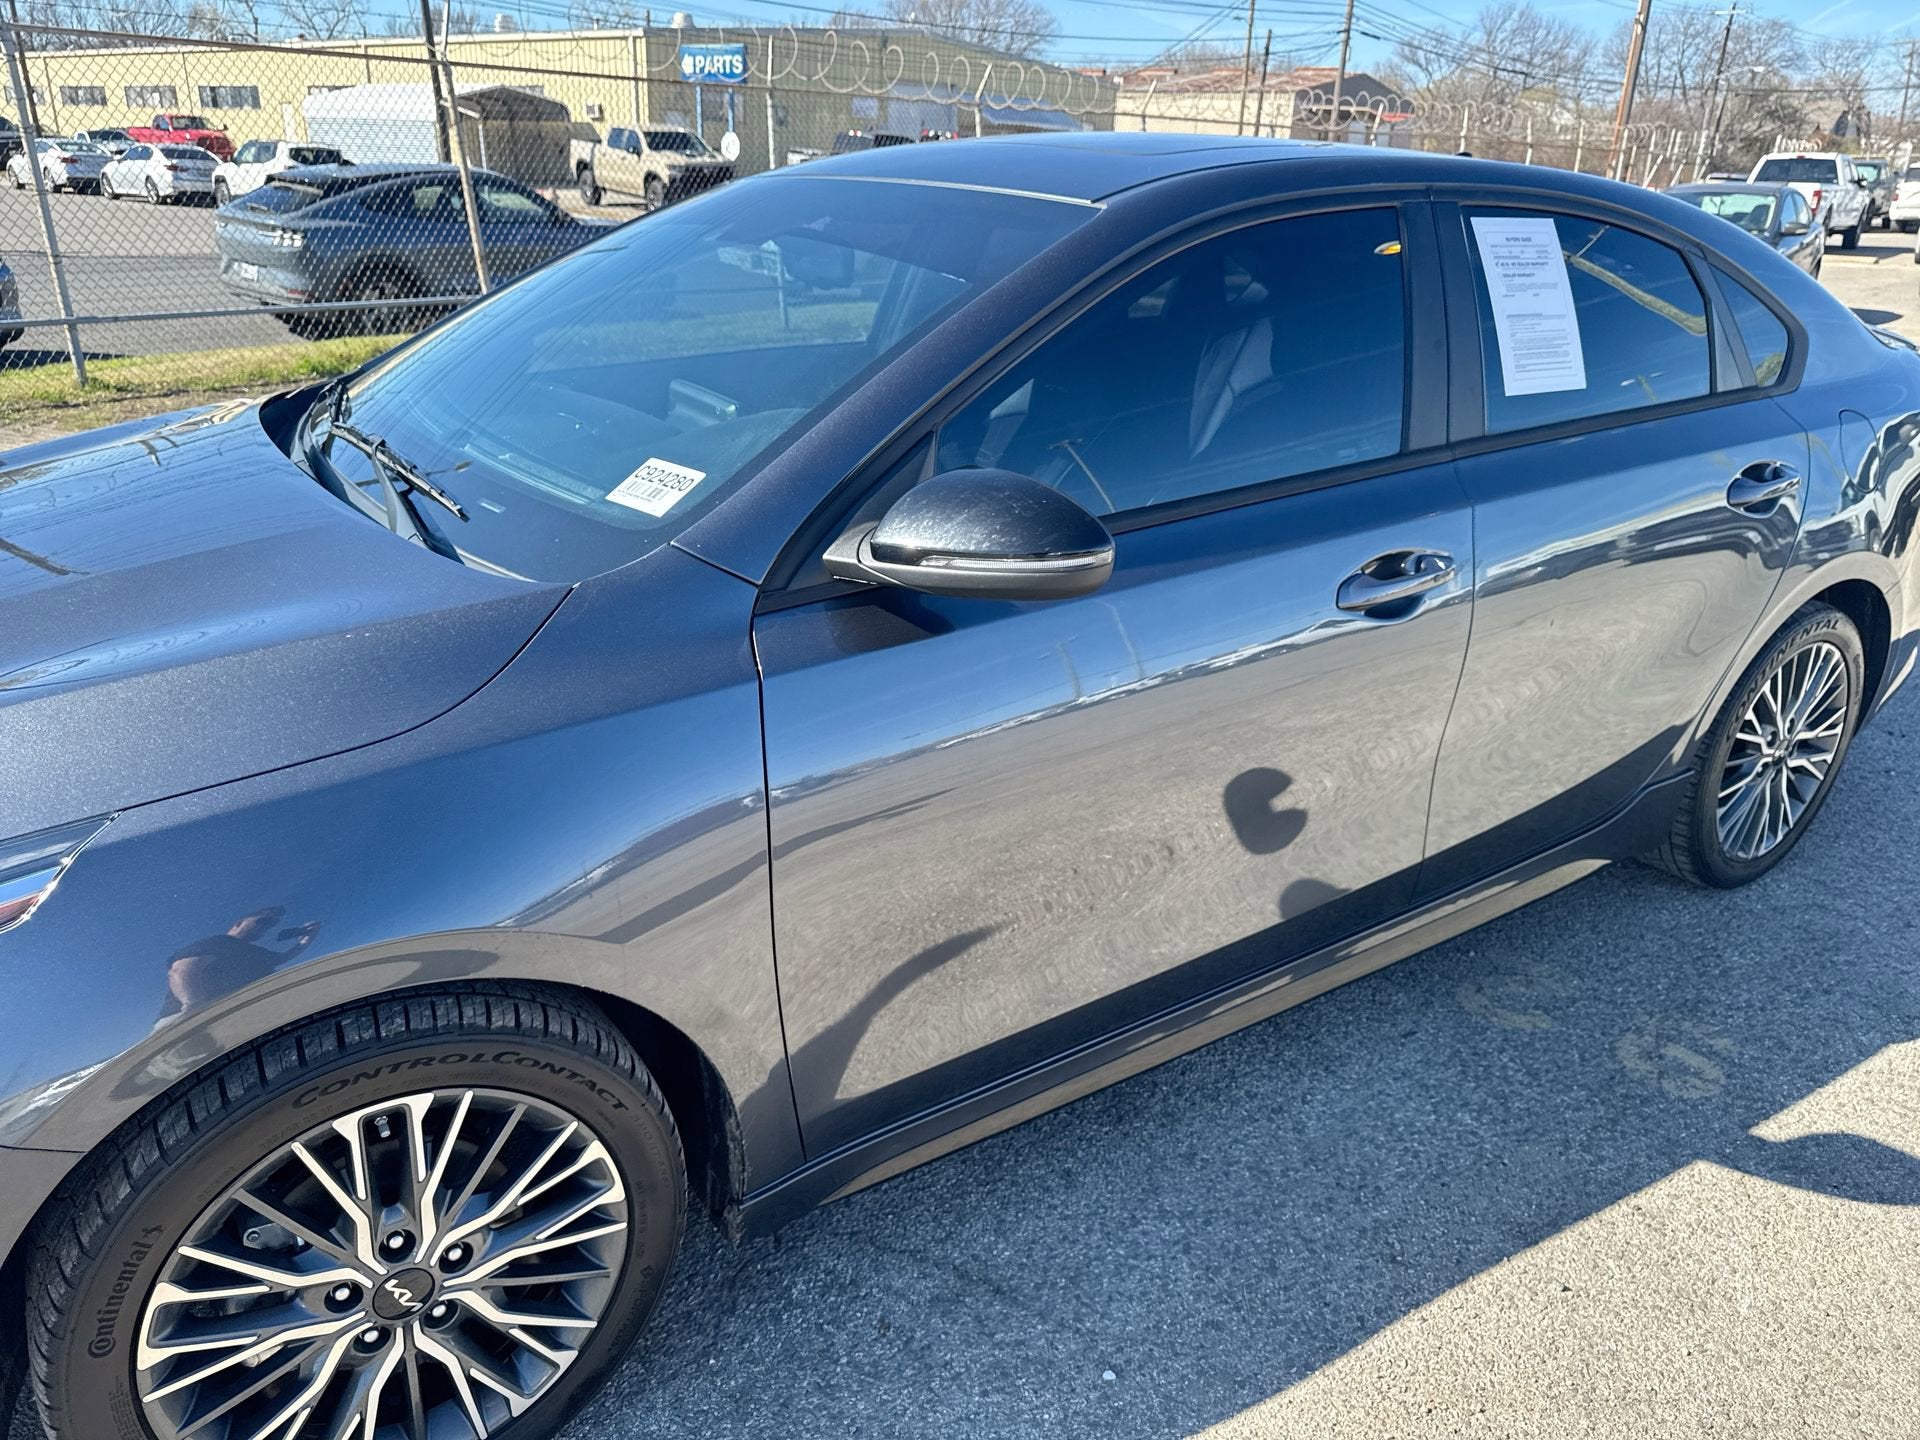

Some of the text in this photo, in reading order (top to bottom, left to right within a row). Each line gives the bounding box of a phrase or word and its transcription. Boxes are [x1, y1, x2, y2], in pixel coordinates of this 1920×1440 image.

[695, 54, 744, 74] PARTS
[634, 465, 695, 492] C924280
[88, 1240, 155, 1359] Continental
